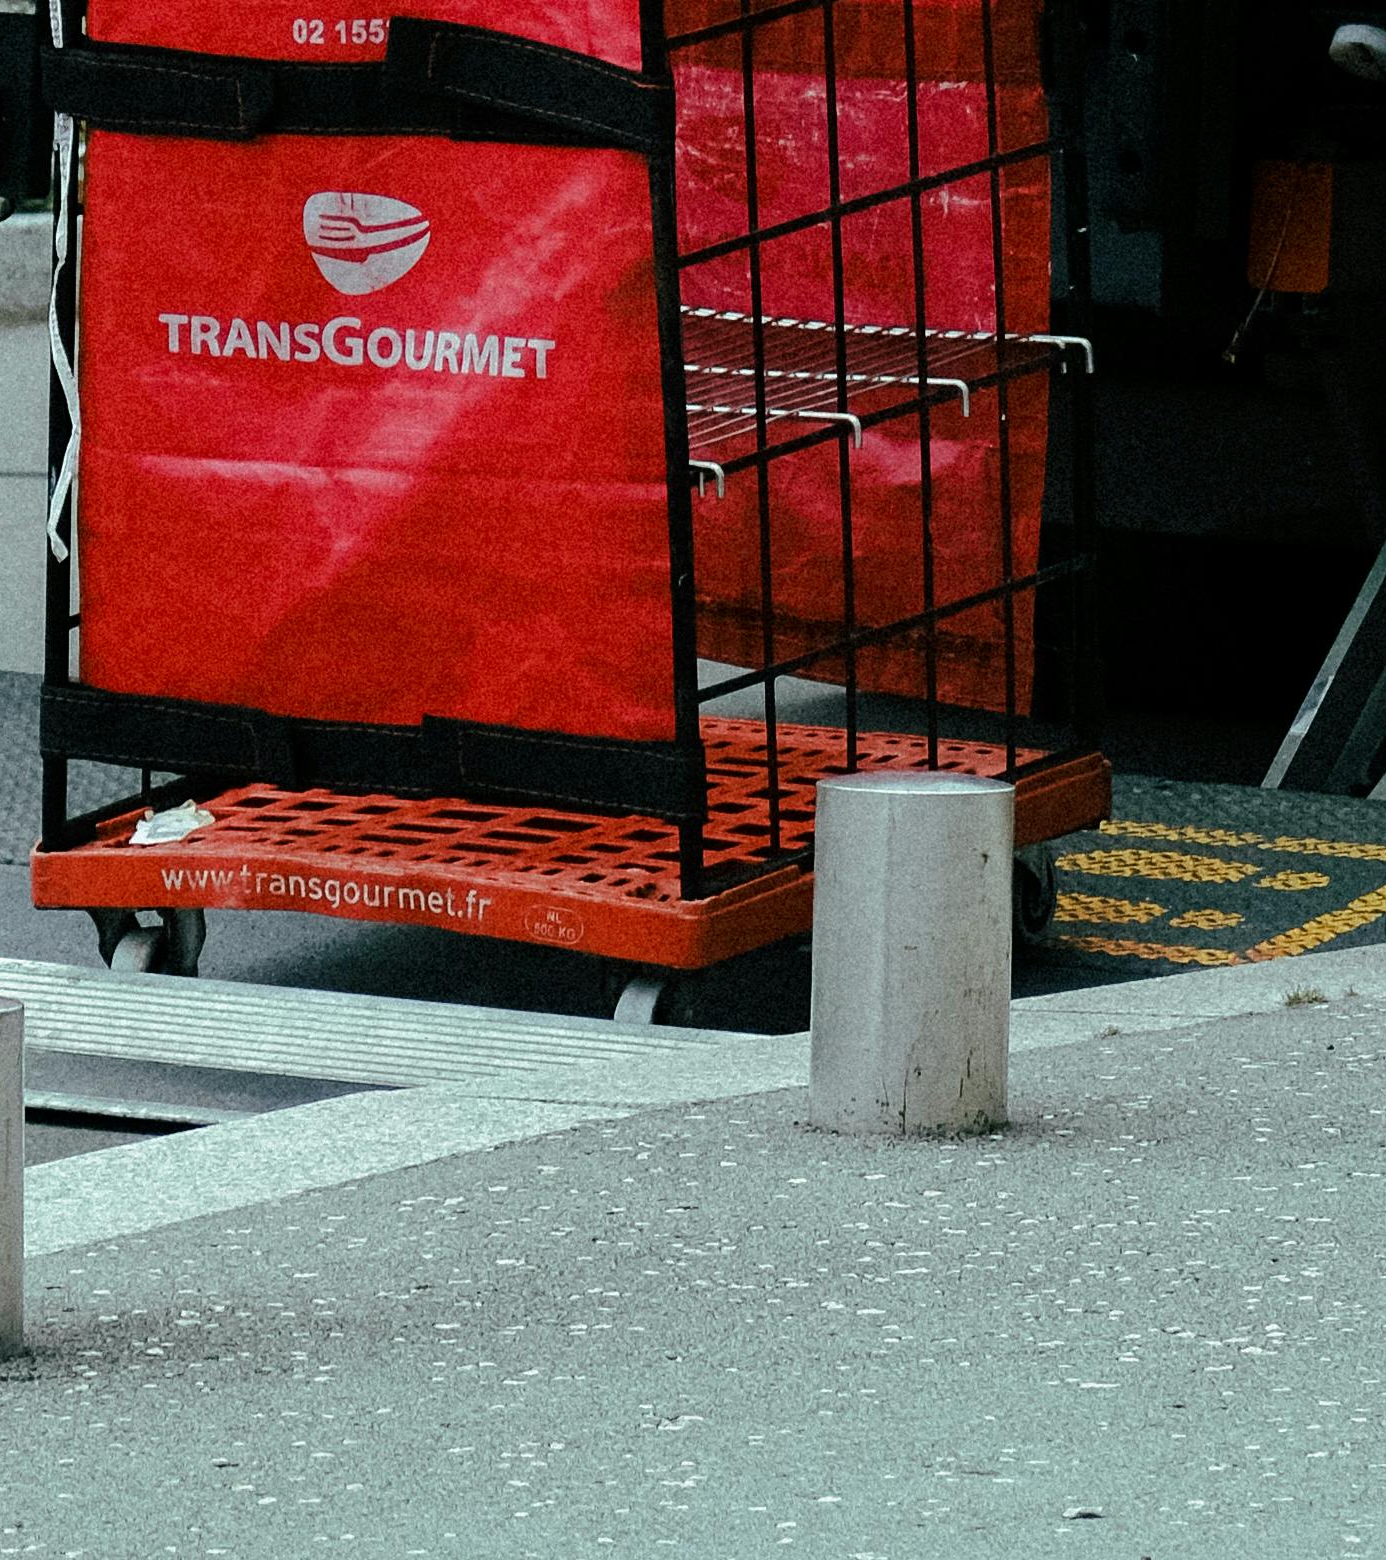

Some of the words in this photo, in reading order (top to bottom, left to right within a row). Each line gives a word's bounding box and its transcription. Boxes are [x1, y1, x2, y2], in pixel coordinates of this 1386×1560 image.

[293, 18, 325, 45] 02
[334, 18, 390, 45] 155
[158, 312, 556, 380] TRANSGOURMET
